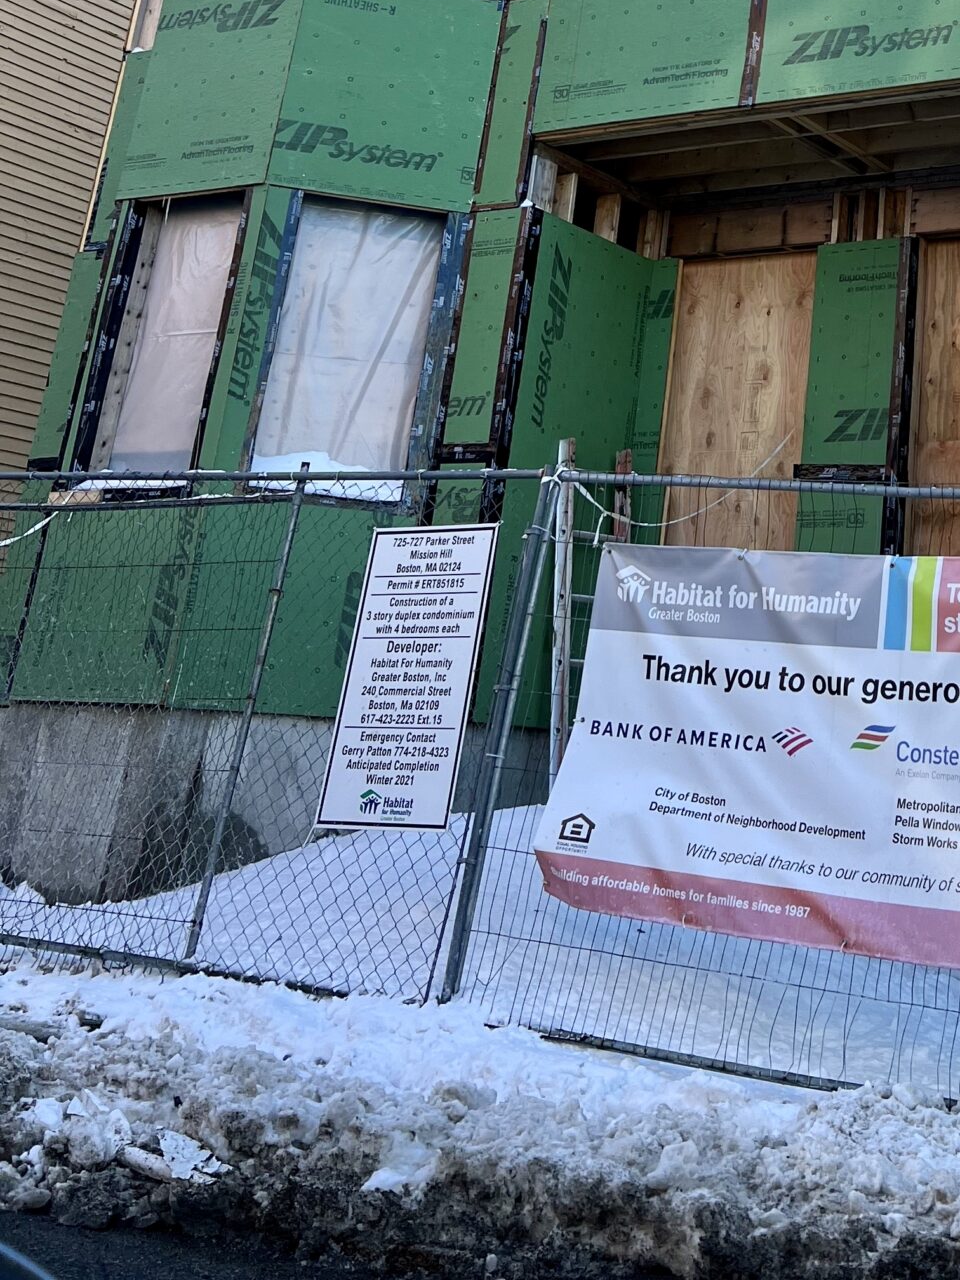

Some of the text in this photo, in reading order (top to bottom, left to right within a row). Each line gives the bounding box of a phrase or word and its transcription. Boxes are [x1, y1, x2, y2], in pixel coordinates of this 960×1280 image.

[393, 535, 475, 547] 725-727 Parker Street
[410, 549, 453, 559] Mission Hill
[396, 562, 462, 574] Boston, MA 02124
[387, 578, 465, 590] Permit # ERT851815
[389, 596, 454, 607] Construction of a
[651, 580, 861, 621] Habitat for Humanity
[366, 609, 475, 623] 3 story duplex condominium
[648, 606, 721, 624] Greater Boston
[376, 623, 461, 634] with 4 bedrooms each
[386, 640, 442, 656] Developer:
[370, 657, 453, 670] Habitat For Humanity
[371, 672, 447, 683] Greater Boston, Inc
[642, 654, 717, 686] Thank
[724, 666, 770, 693] you
[778, 666, 805, 693] to
[812, 673, 855, 697] our
[361, 685, 451, 697] 240 Commercial Street
[368, 699, 440, 711] Boston, Ma 02109
[360, 713, 415, 725] 617-423-2223
[360, 731, 436, 744] Emergency Contact
[590, 719, 767, 753] BANK OF AMERICA
[341, 745, 450, 758] Gerry Patton 774-218-4323
[345, 759, 440, 772] Anticipated Completion
[366, 774, 415, 786] Winter 2021
[382, 797, 414, 809] Habitat
[654, 786, 727, 807] City of Boston
[649, 800, 866, 841] Department of Neighborhood Development
[894, 815, 920, 829] Pella
[892, 832, 925, 847] Storm
[926, 836, 958, 850] Works
[685, 842, 717, 862] With
[718, 848, 766, 869] special
[768, 854, 816, 875] thanks
[817, 862, 833, 877] to
[834, 867, 859, 881] our
[861, 870, 937, 893] community
[938, 877, 954, 892] of
[591, 873, 651, 894] affordable
[652, 884, 687, 900] homes
[688, 888, 705, 902] for
[706, 891, 749, 910] families
[751, 898, 783, 915] since
[784, 903, 811, 919] 1987
